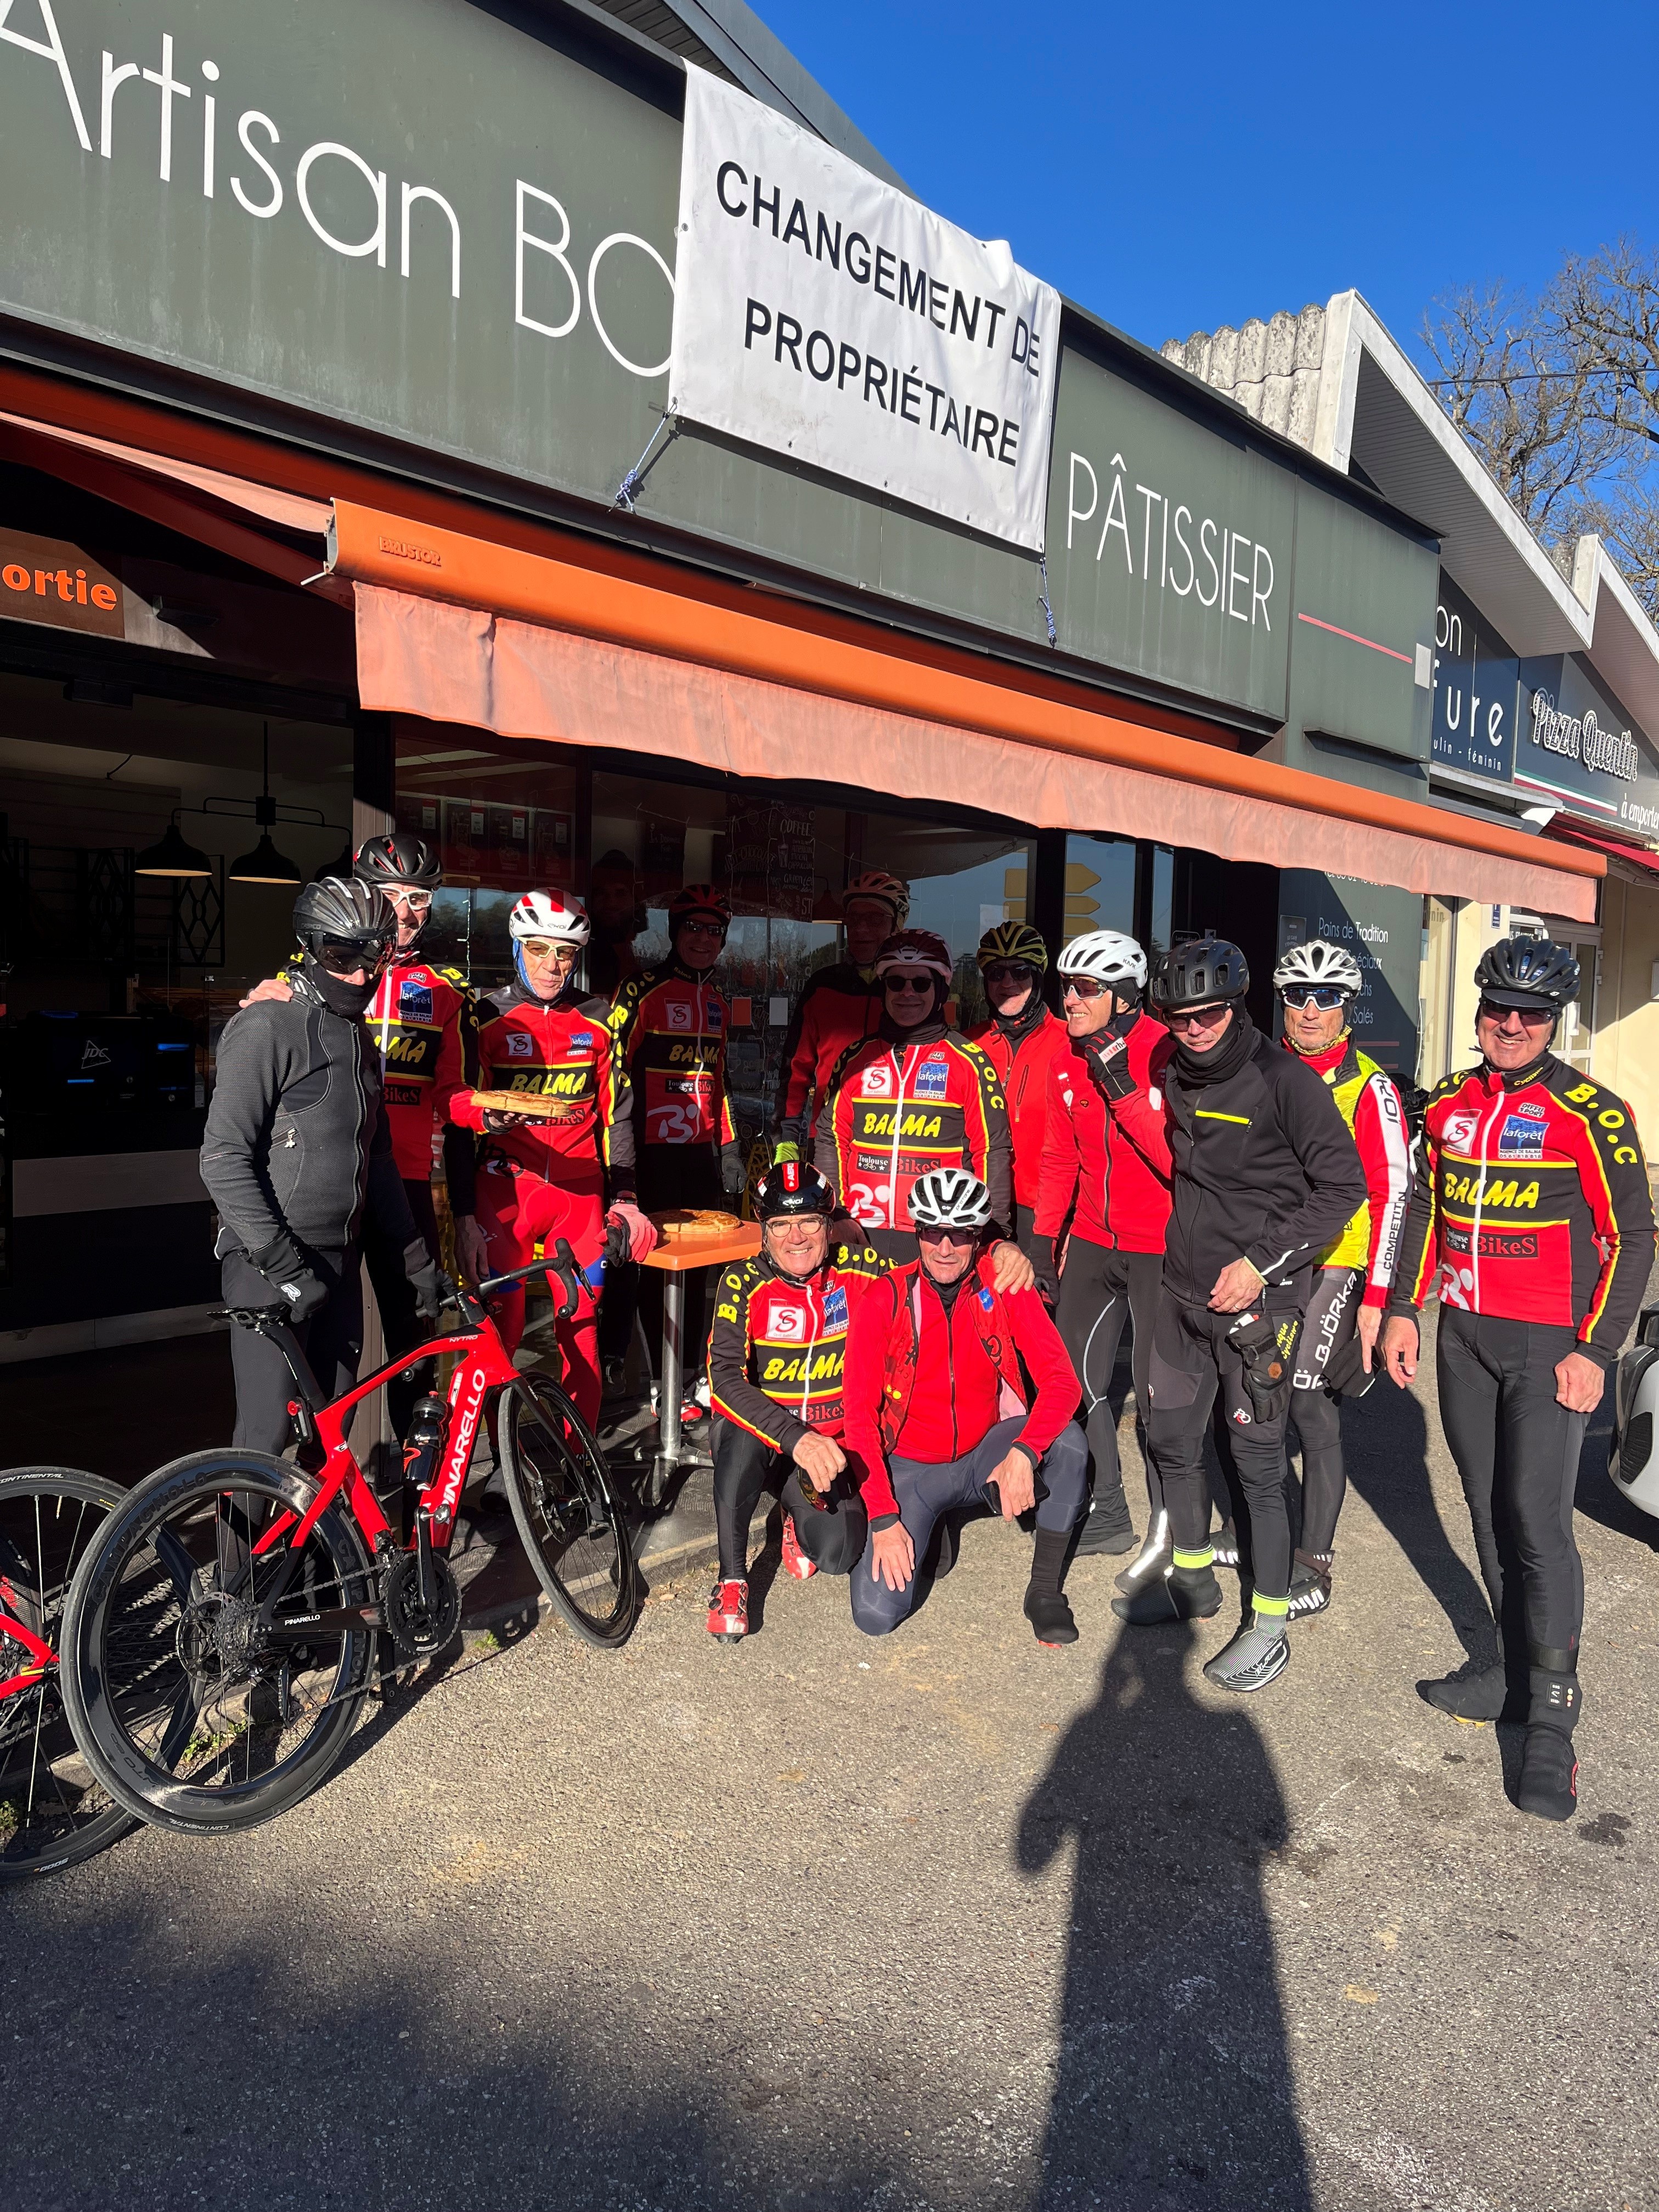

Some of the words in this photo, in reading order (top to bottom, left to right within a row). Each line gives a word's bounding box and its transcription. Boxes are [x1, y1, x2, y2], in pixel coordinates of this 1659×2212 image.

[716, 160, 1006, 349] CHANGEMENT
[1011, 314, 1041, 378] DE
[743, 296, 1020, 468] PROPRIÉTAIRE
[379, 537, 441, 567] BRUSTOR
[1067, 452, 1274, 631] PÂTISSIER
[1531, 687, 1582, 759] Pizza
[1583, 710, 1638, 782] Quentin
[1468, 748, 1501, 771] féminin
[1318, 917, 1340, 938] Pains
[1342, 921, 1353, 940] de
[1355, 921, 1389, 944] Tradition
[402, 990, 431, 1005] laforêt
[1352, 1006, 1374, 1024] Salés
[510, 1072, 587, 1095] BALMA
[918, 1071, 946, 1082] laforêt
[961, 1042, 1005, 1110] B.O.C
[1520, 1108, 1543, 1117] SPORT
[1564, 1082, 1637, 1165] B.O.C
[864, 1113, 941, 1138] BALMA
[1503, 1127, 1542, 1141] laforêt
[858, 1154, 889, 1166] Toulouse
[888, 1158, 940, 1174] BikeS
[1444, 1172, 1540, 1209] BALMA
[1469, 1235, 1536, 1255] BikeS
[824, 1299, 847, 1317] laforêt
[284, 1614, 321, 1626] PINARELLO
[169, 1818, 230, 1831] CONTINENTAL
